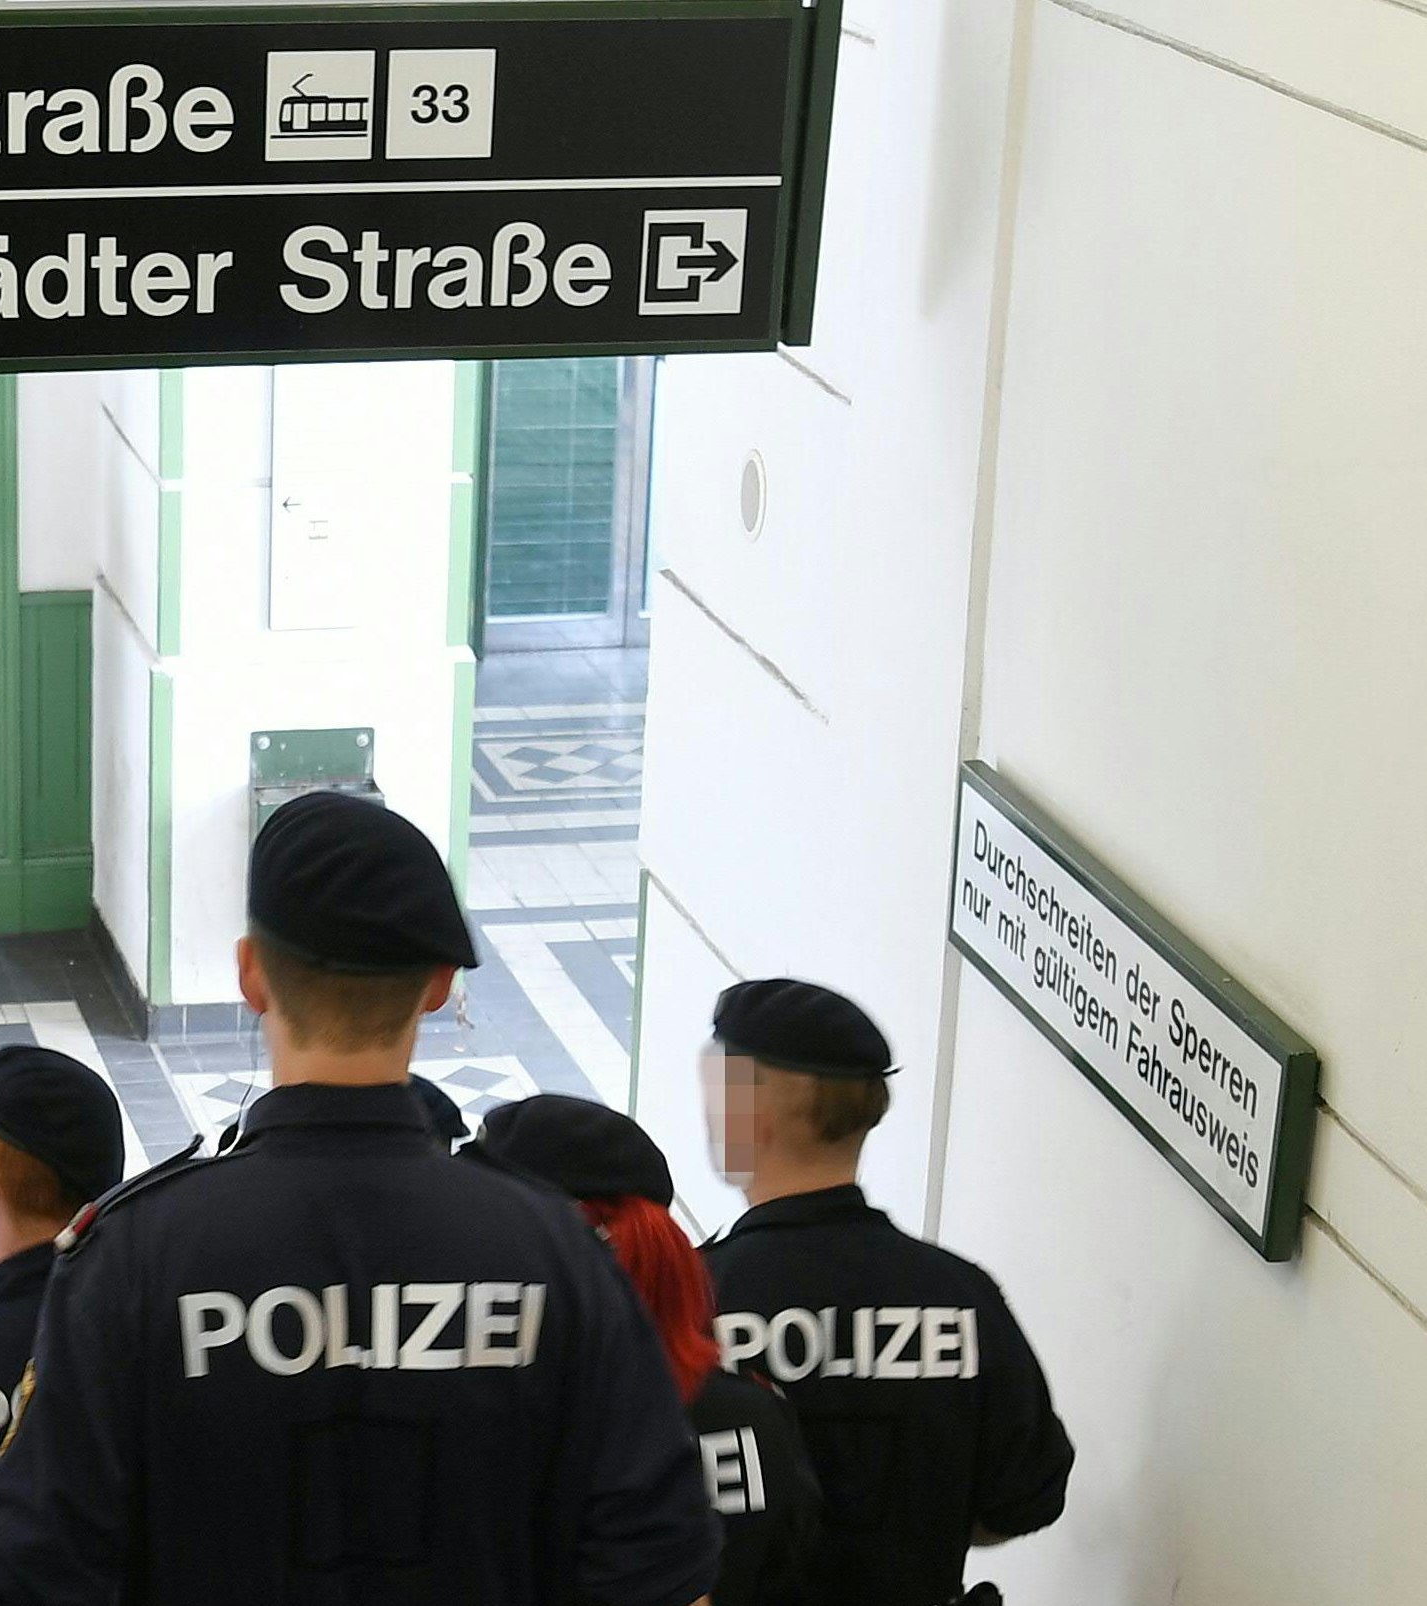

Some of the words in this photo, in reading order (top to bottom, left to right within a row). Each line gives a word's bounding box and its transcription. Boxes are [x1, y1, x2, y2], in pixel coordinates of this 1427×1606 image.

[410, 84, 470, 124] 33
[279, 222, 612, 314] Straße
[973, 820, 1117, 985] Durchschreiten
[1125, 963, 1161, 1023] der
[1168, 998, 1258, 1119] Sperren
[962, 878, 991, 925] nur
[998, 910, 1026, 961] mit
[1033, 946, 1119, 1050] gültigem
[1125, 1021, 1259, 1188] Fahrausweis
[177, 1282, 547, 1379] POLIZEI
[713, 1306, 980, 1382] POLIZEI
